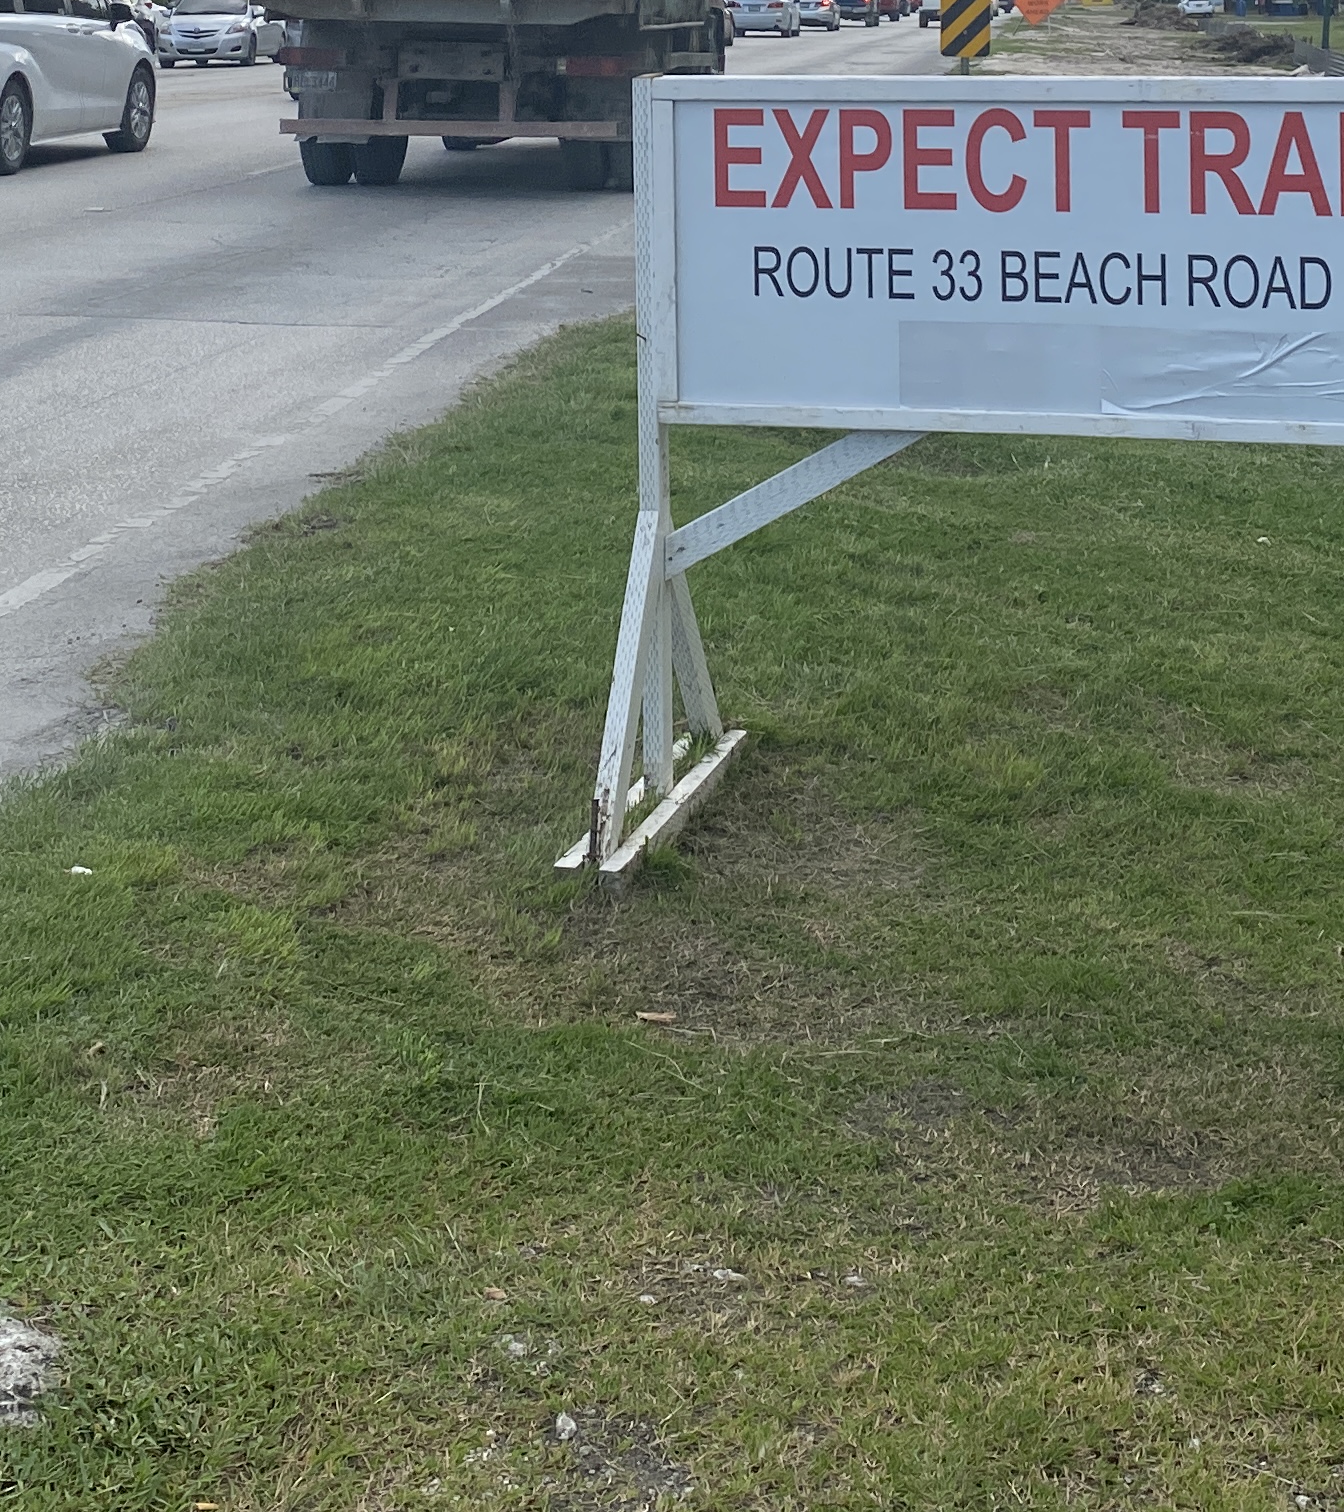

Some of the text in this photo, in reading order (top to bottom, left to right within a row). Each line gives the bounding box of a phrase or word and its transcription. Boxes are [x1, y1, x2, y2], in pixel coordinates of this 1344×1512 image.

[714, 108, 1090, 213] EXPECT
[753, 245, 916, 300] ROUTE
[932, 249, 983, 302] 33
[1000, 250, 1167, 307] BEACH
[1187, 254, 1332, 310] ROAD
